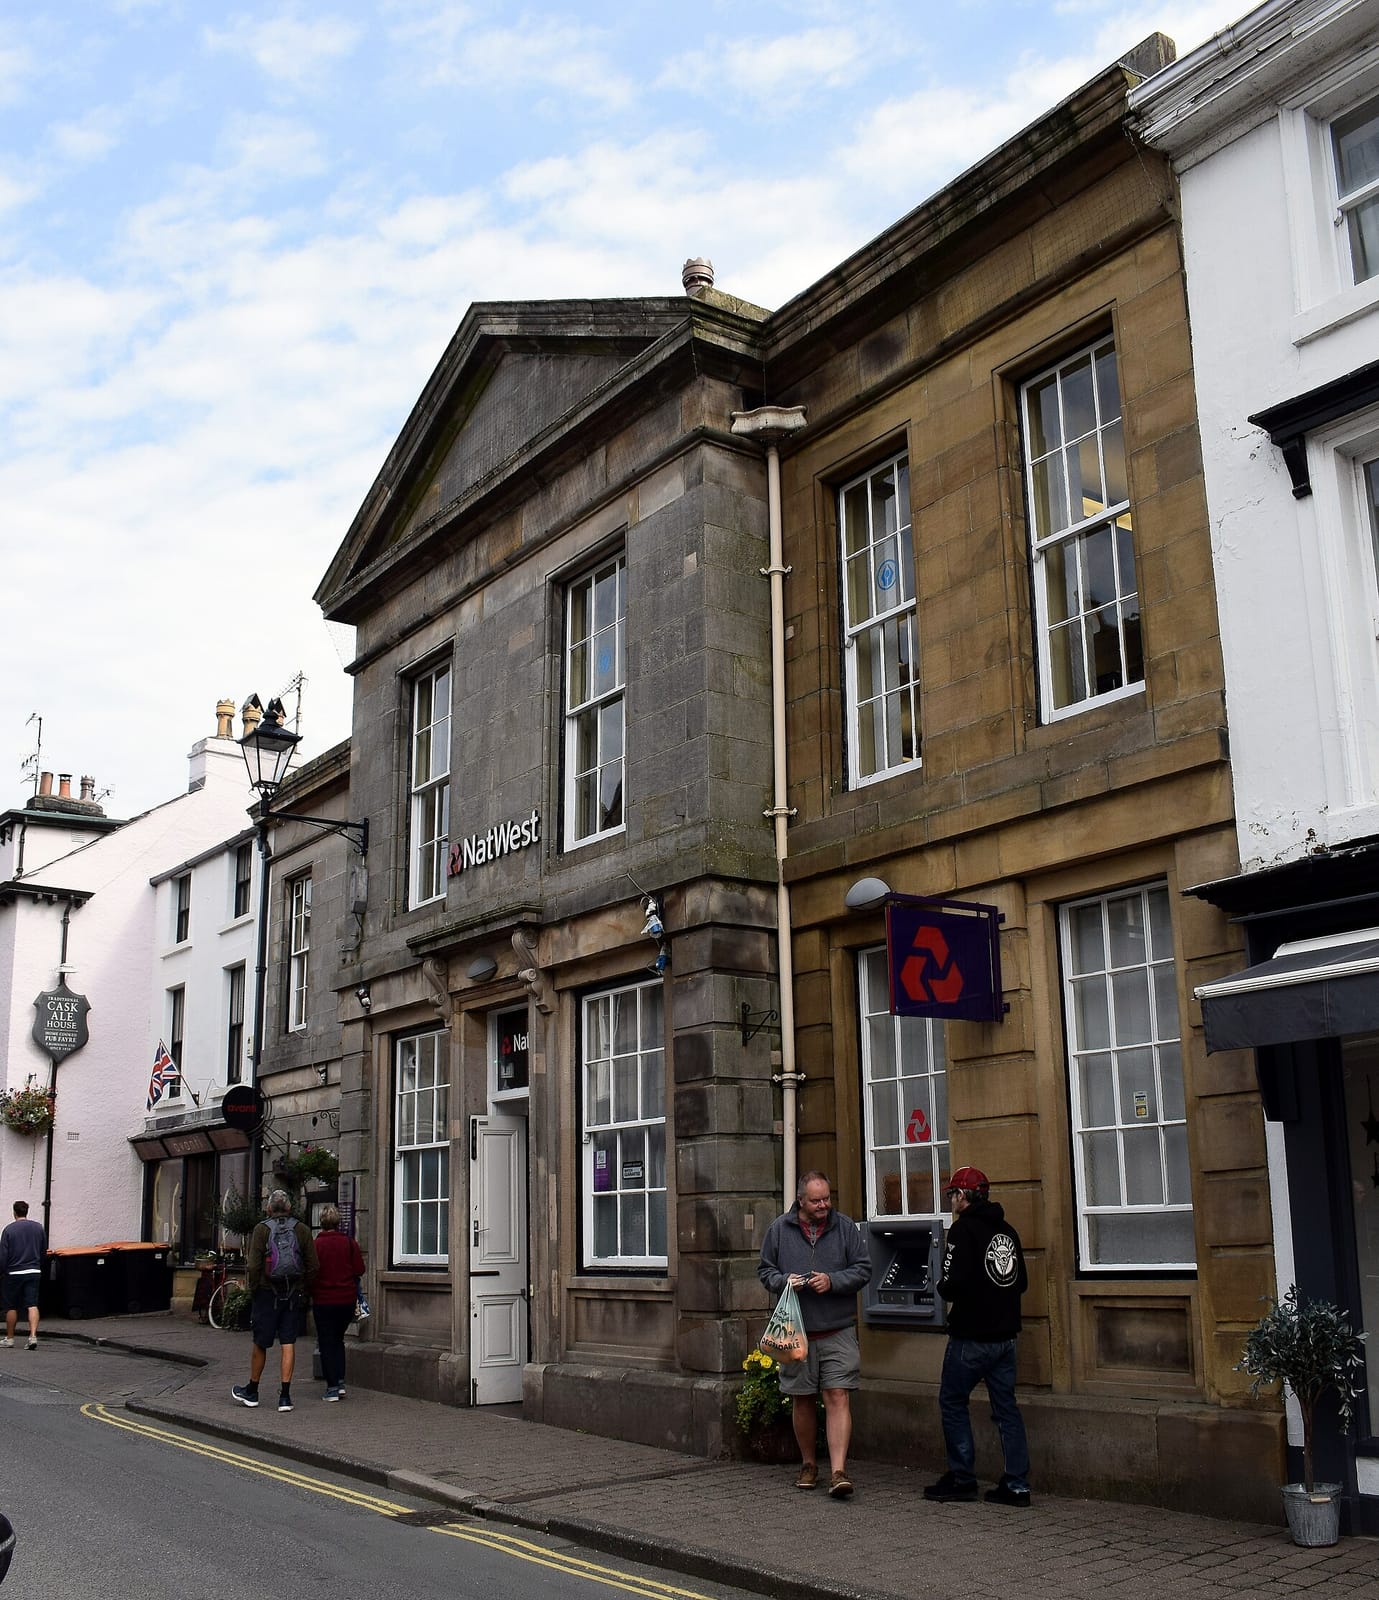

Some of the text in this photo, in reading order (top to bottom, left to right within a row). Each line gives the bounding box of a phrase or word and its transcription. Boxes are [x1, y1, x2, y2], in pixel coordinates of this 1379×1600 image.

[463, 809, 538, 869] NatWest
[47, 1001, 78, 1012] CASK
[50, 1011, 74, 1022] ALE
[46, 1020, 77, 1029] HOUSE
